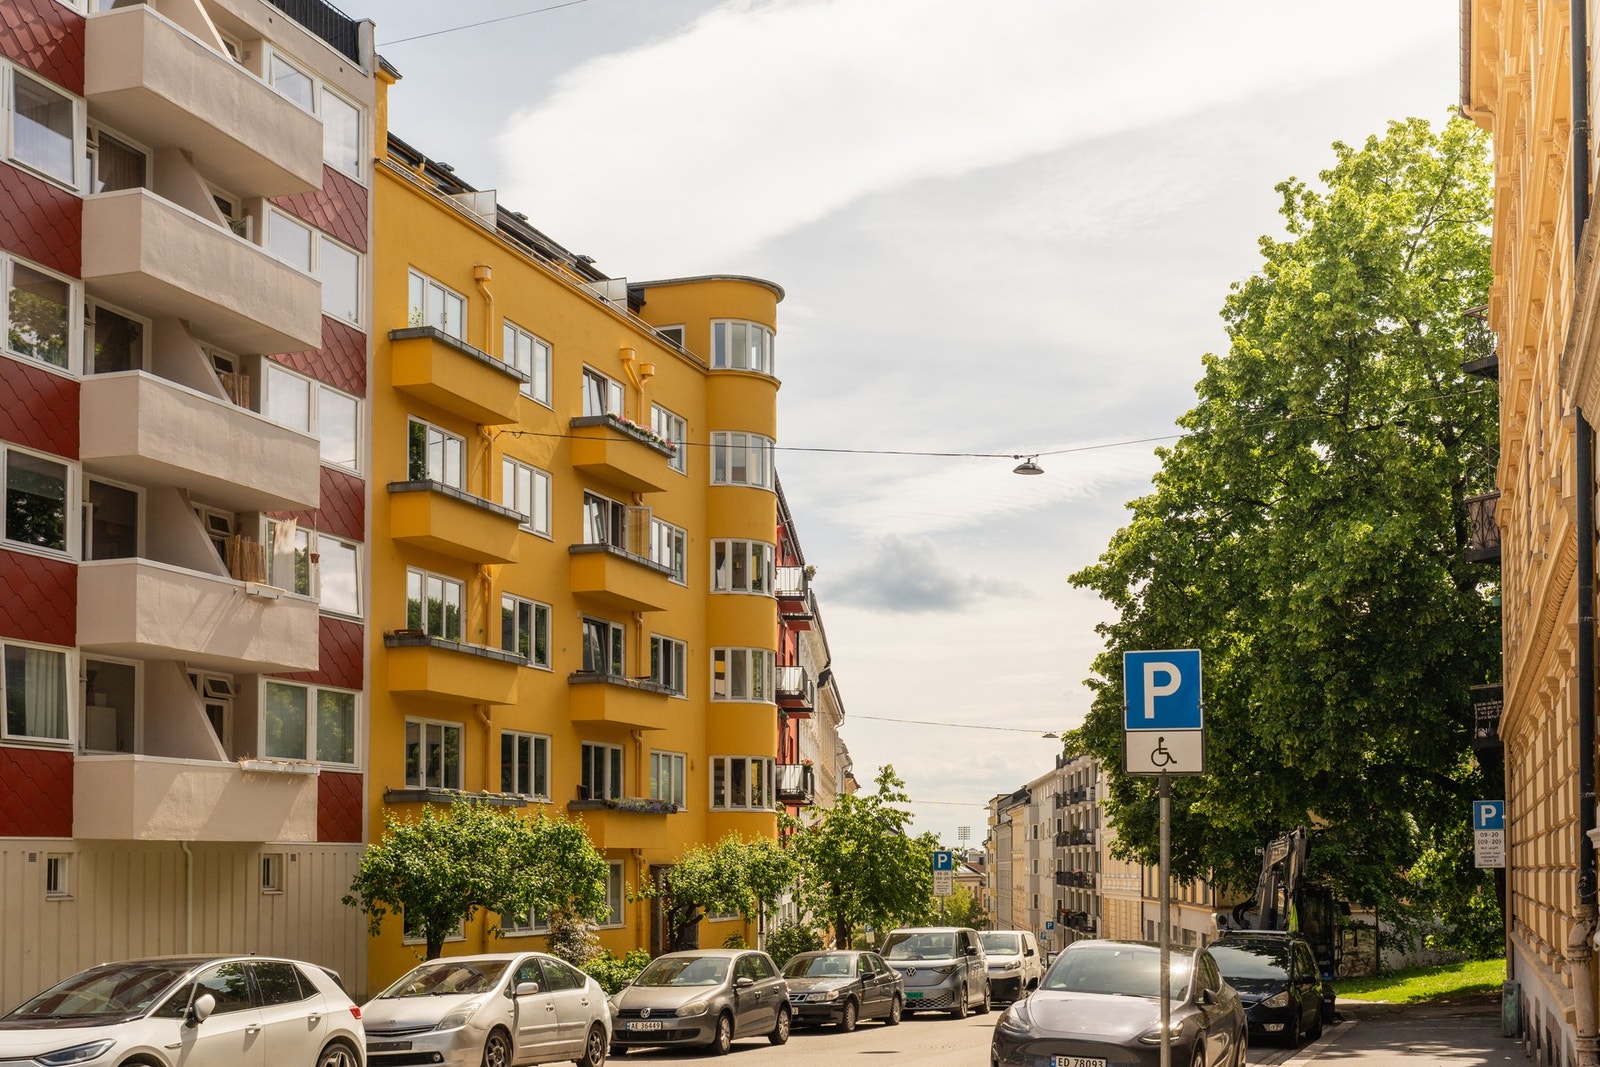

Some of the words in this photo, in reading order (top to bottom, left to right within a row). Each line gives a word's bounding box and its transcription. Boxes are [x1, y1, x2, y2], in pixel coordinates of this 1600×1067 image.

[1143, 661, 1182, 719] P
[1480, 804, 1497, 826] P
[937, 853, 948, 869] P
[631, 1022, 639, 1030] AE
[641, 1022, 661, 1030] 36449
[1058, 1057, 1070, 1067] ED
[1073, 1058, 1103, 1067] 78093
